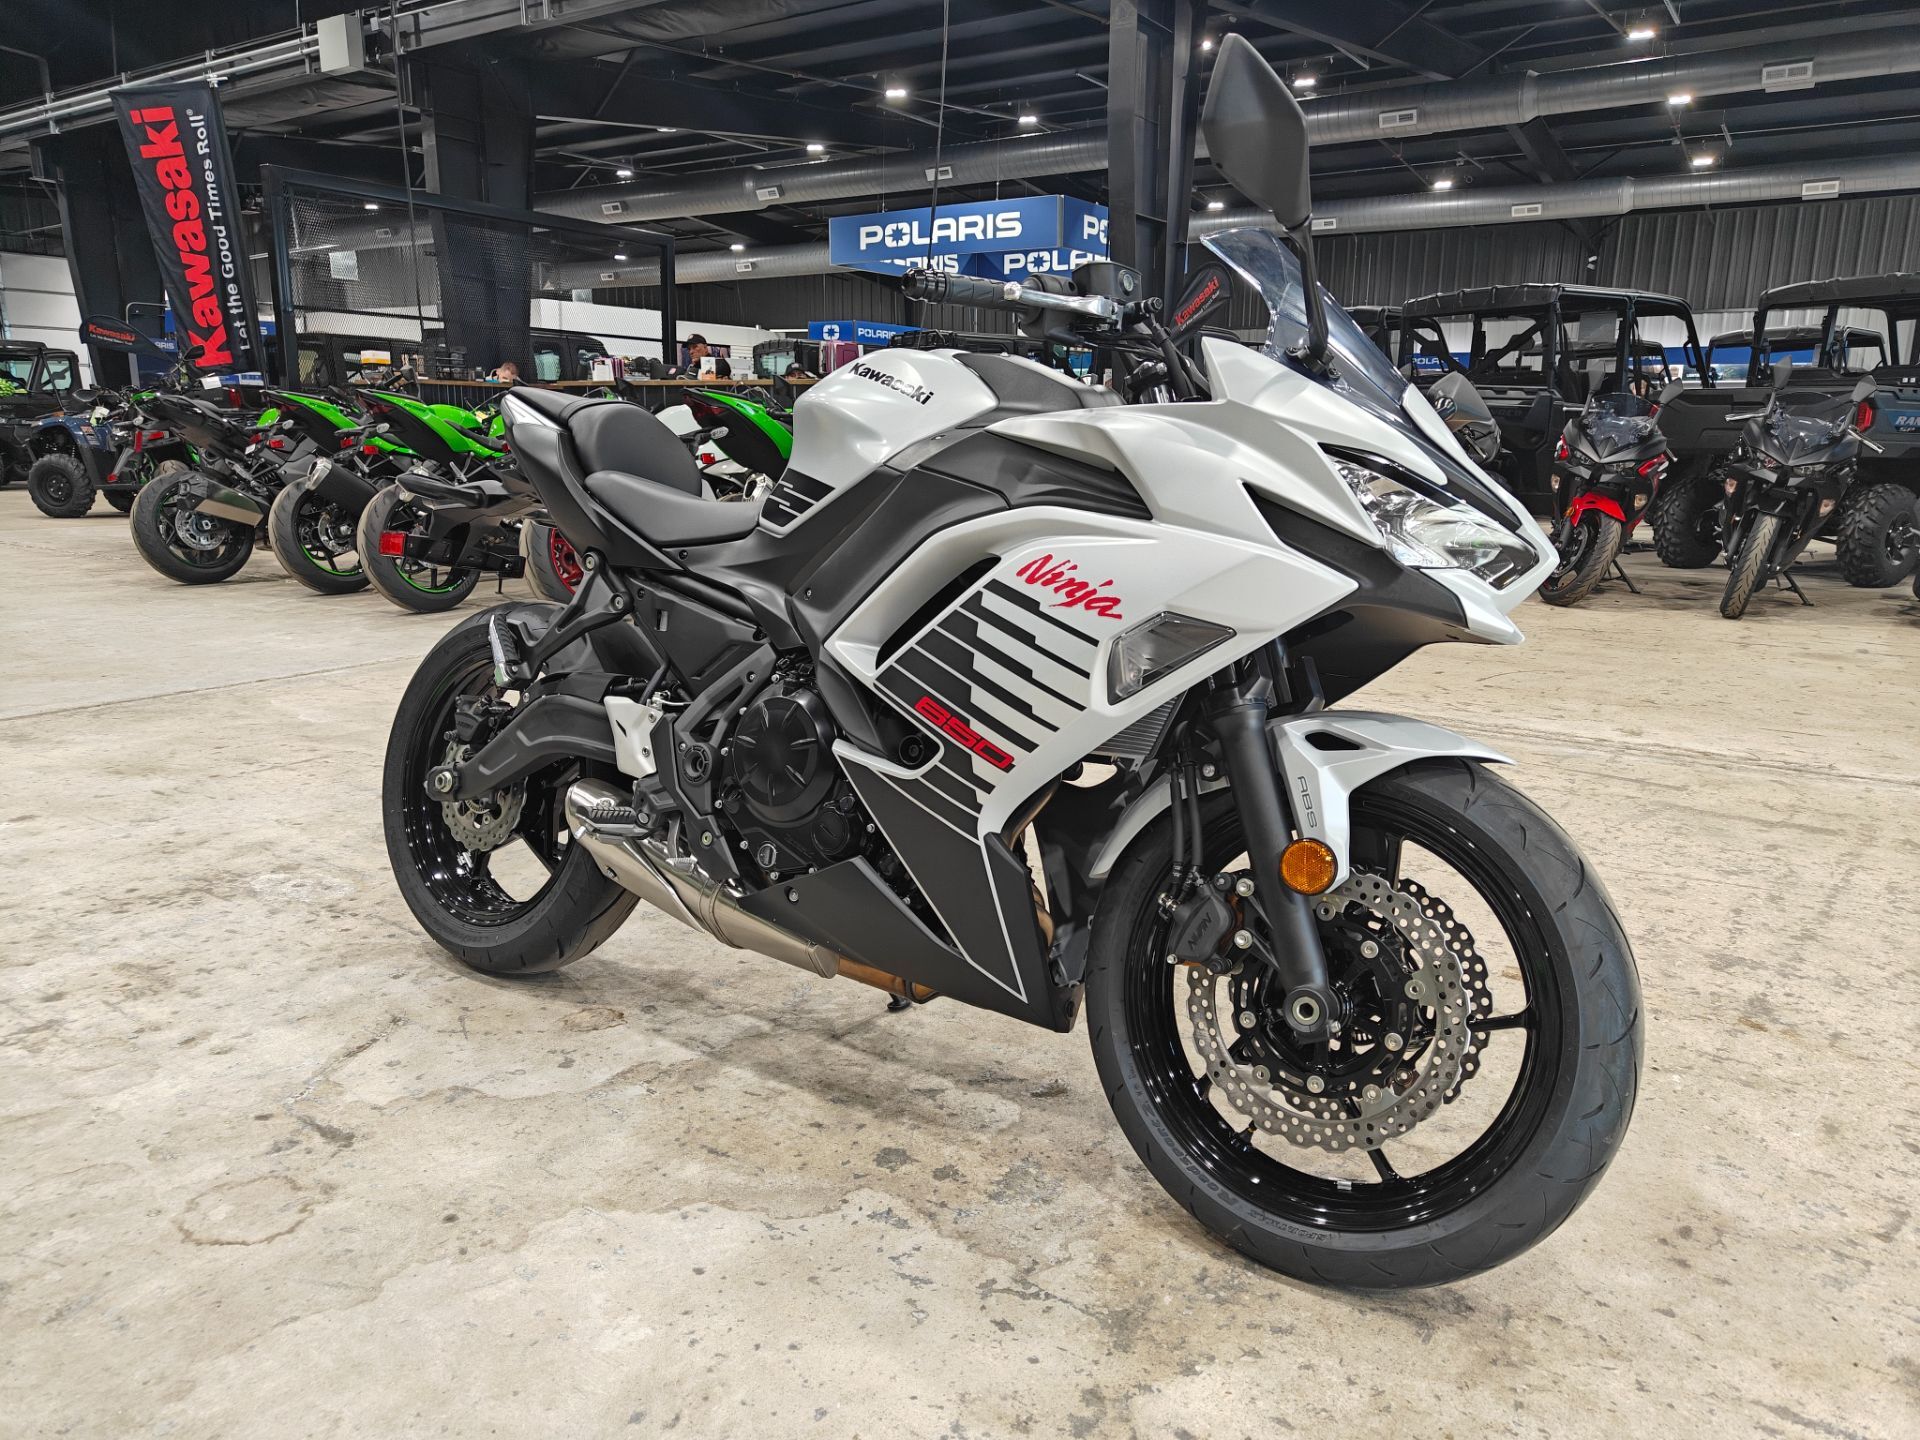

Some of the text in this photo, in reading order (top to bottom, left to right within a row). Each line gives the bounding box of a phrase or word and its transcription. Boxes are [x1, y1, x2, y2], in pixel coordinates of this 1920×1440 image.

[203, 158, 223, 221] Times
[130, 106, 233, 367] Kawasaki
[213, 225, 235, 279] Good
[859, 211, 1022, 250] POLARIS
[227, 283, 244, 314] the
[233, 320, 250, 350] Let
[848, 362, 935, 405] Kawasaki
[1016, 553, 1123, 620] Ninja
[915, 696, 1015, 769] 650
[1297, 775, 1318, 829] ABS
